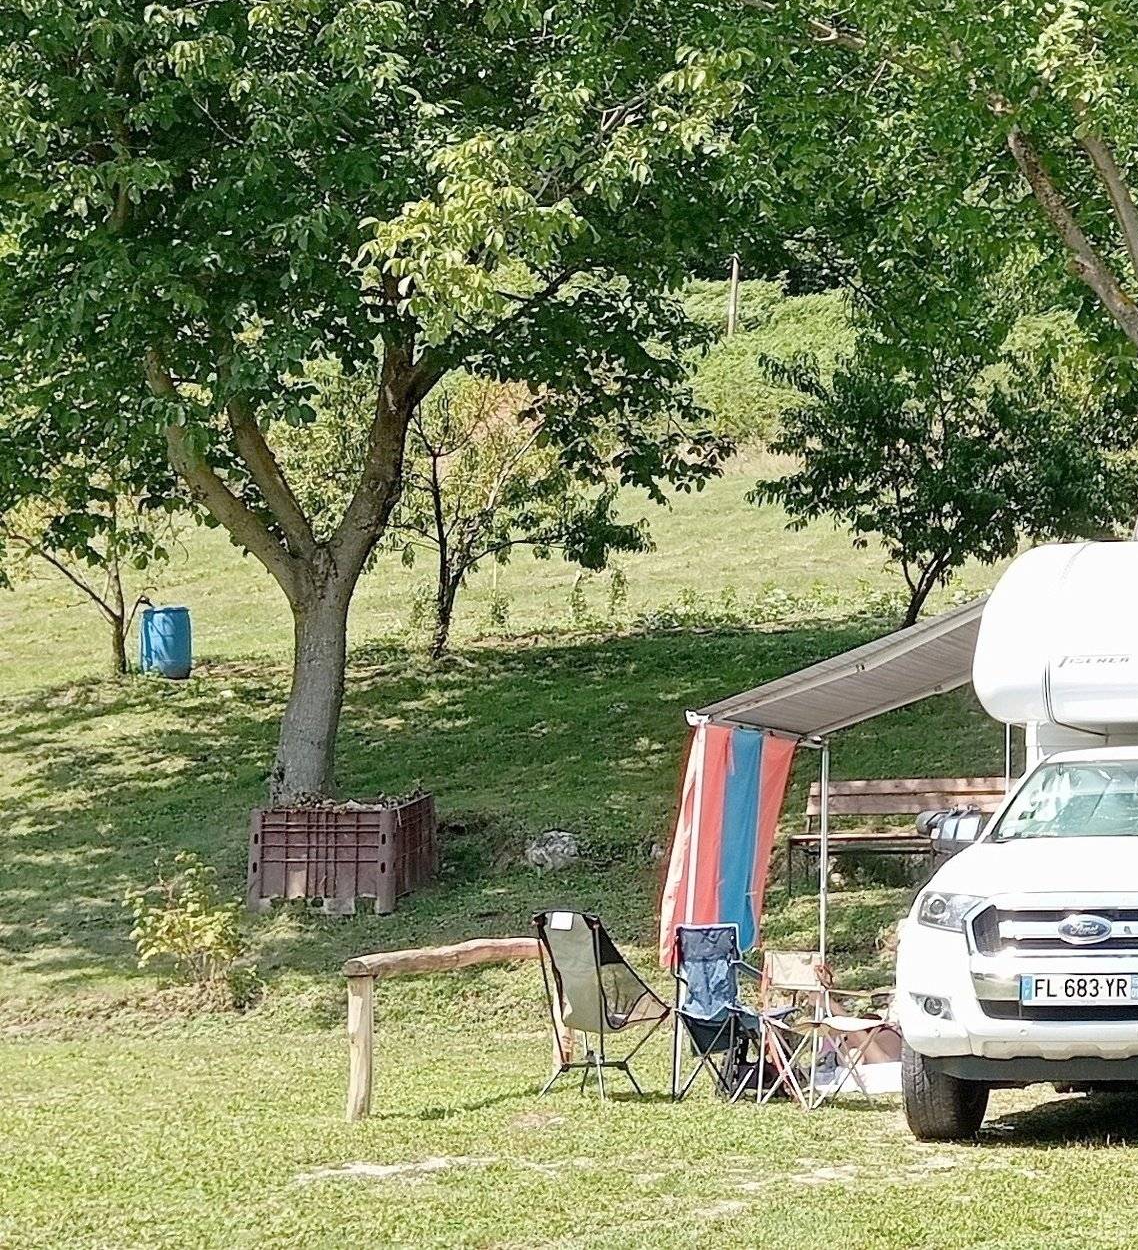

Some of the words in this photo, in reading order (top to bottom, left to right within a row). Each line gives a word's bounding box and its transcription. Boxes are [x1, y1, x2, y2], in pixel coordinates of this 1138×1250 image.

[1067, 920, 1099, 935] Ford
[1035, 979, 1057, 997] FL
[1064, 979, 1099, 997] 683
[1106, 978, 1127, 997] YR
